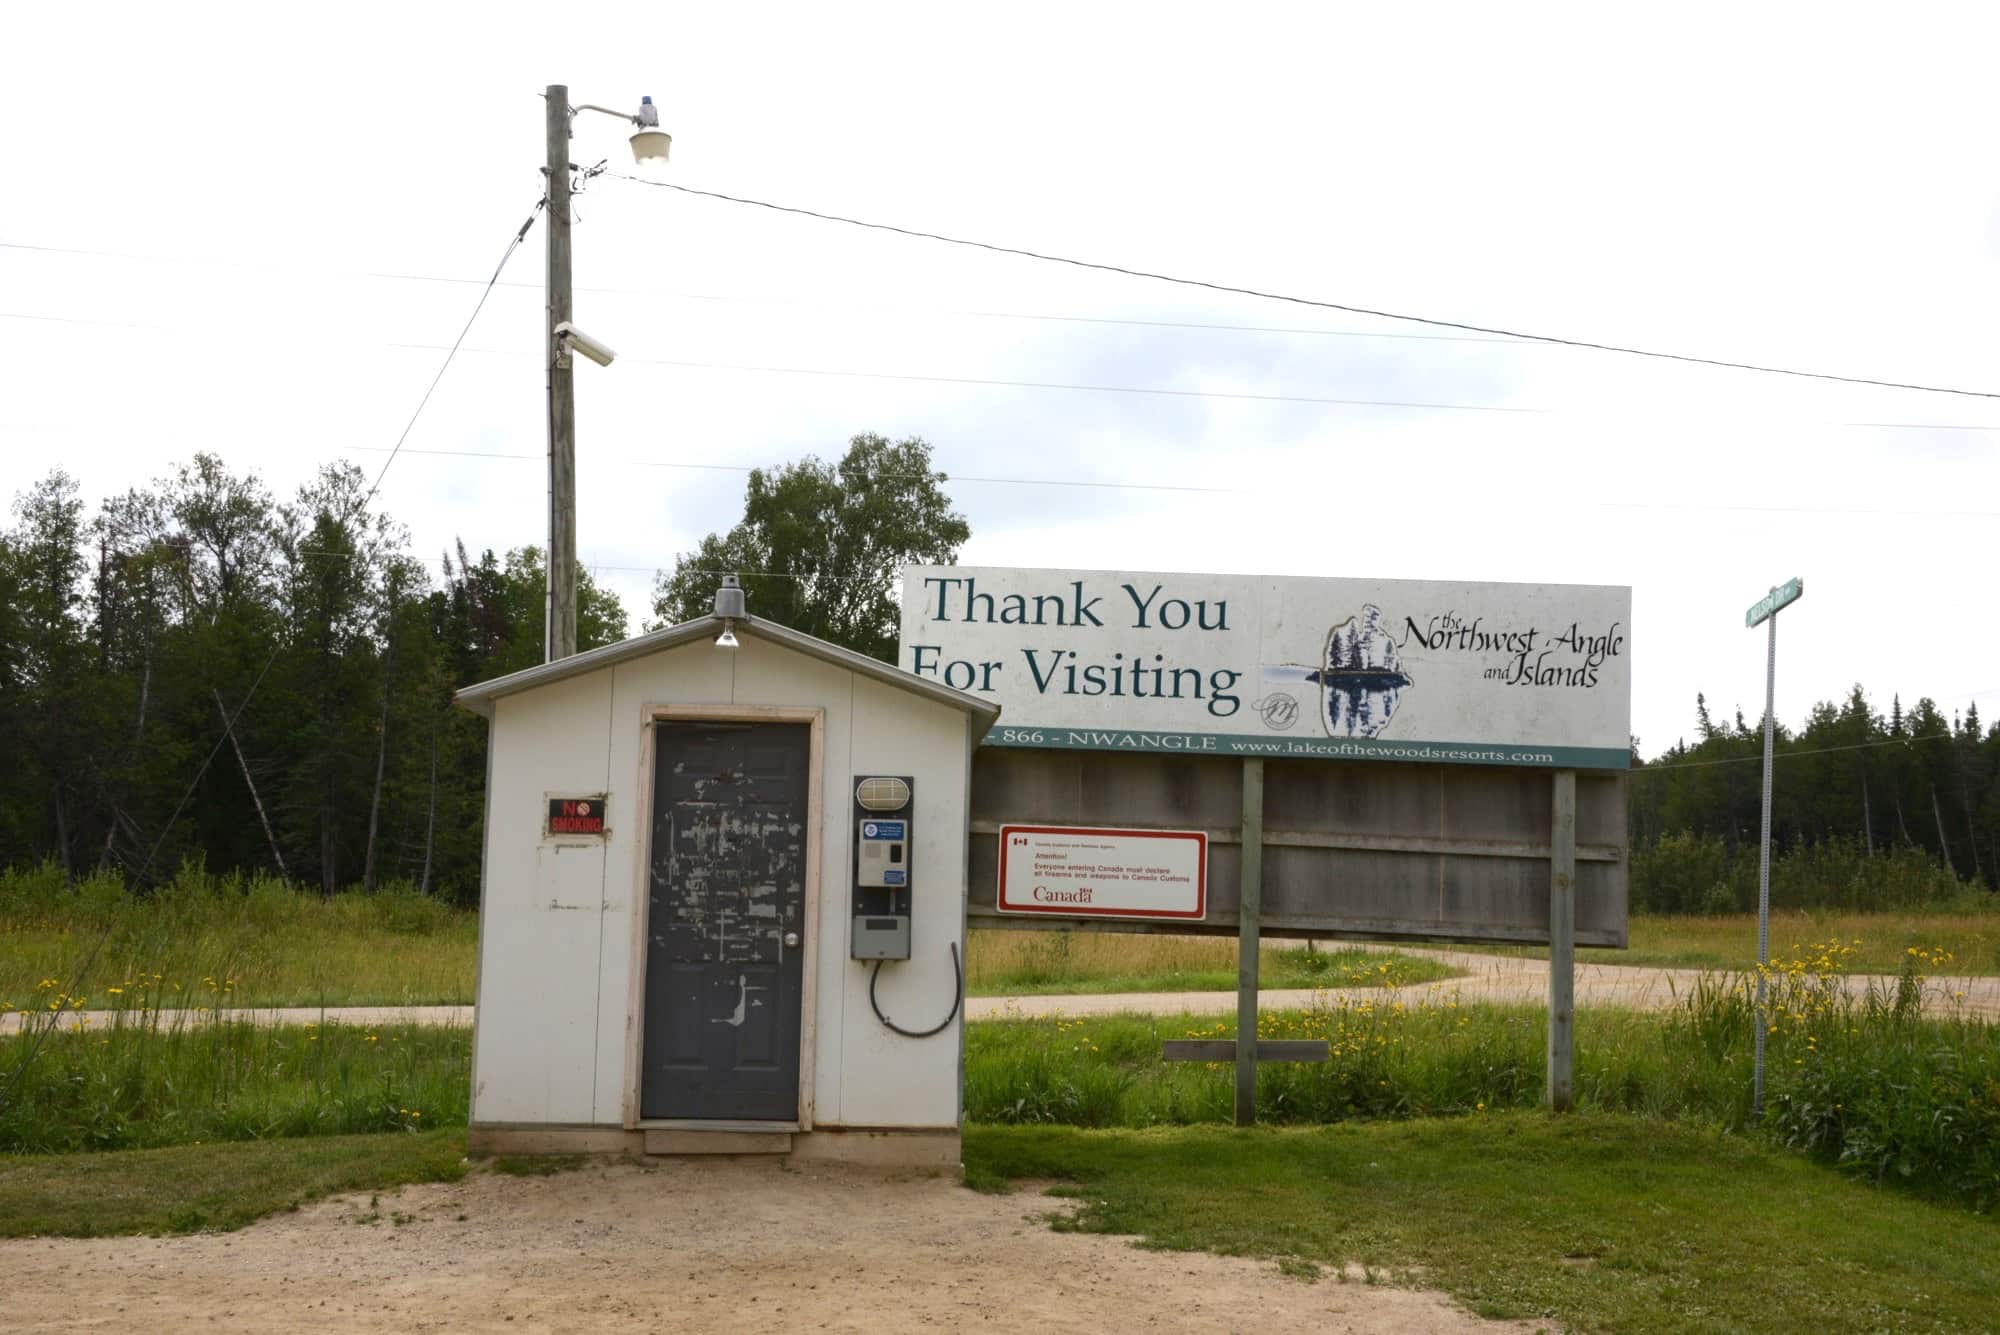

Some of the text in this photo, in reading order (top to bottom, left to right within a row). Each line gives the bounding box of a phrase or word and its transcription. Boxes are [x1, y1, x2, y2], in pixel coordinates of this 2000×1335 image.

[924, 577, 1230, 631] Thank You
[1442, 610, 1462, 630] the
[1397, 616, 1624, 668] Northwest Angle
[909, 645, 1242, 717] For Visiting
[1483, 651, 1599, 688] and Islands
[1003, 729, 1044, 744] 866
[1067, 732, 1217, 750] NWANGLE
[1231, 741, 1554, 763] www.lakeofthewoodsresorts.com
[552, 816, 601, 833] SMOKING
[1035, 863, 1065, 871] Everyone
[1068, 864, 1095, 872] entering
[1033, 885, 1092, 903] Canada
